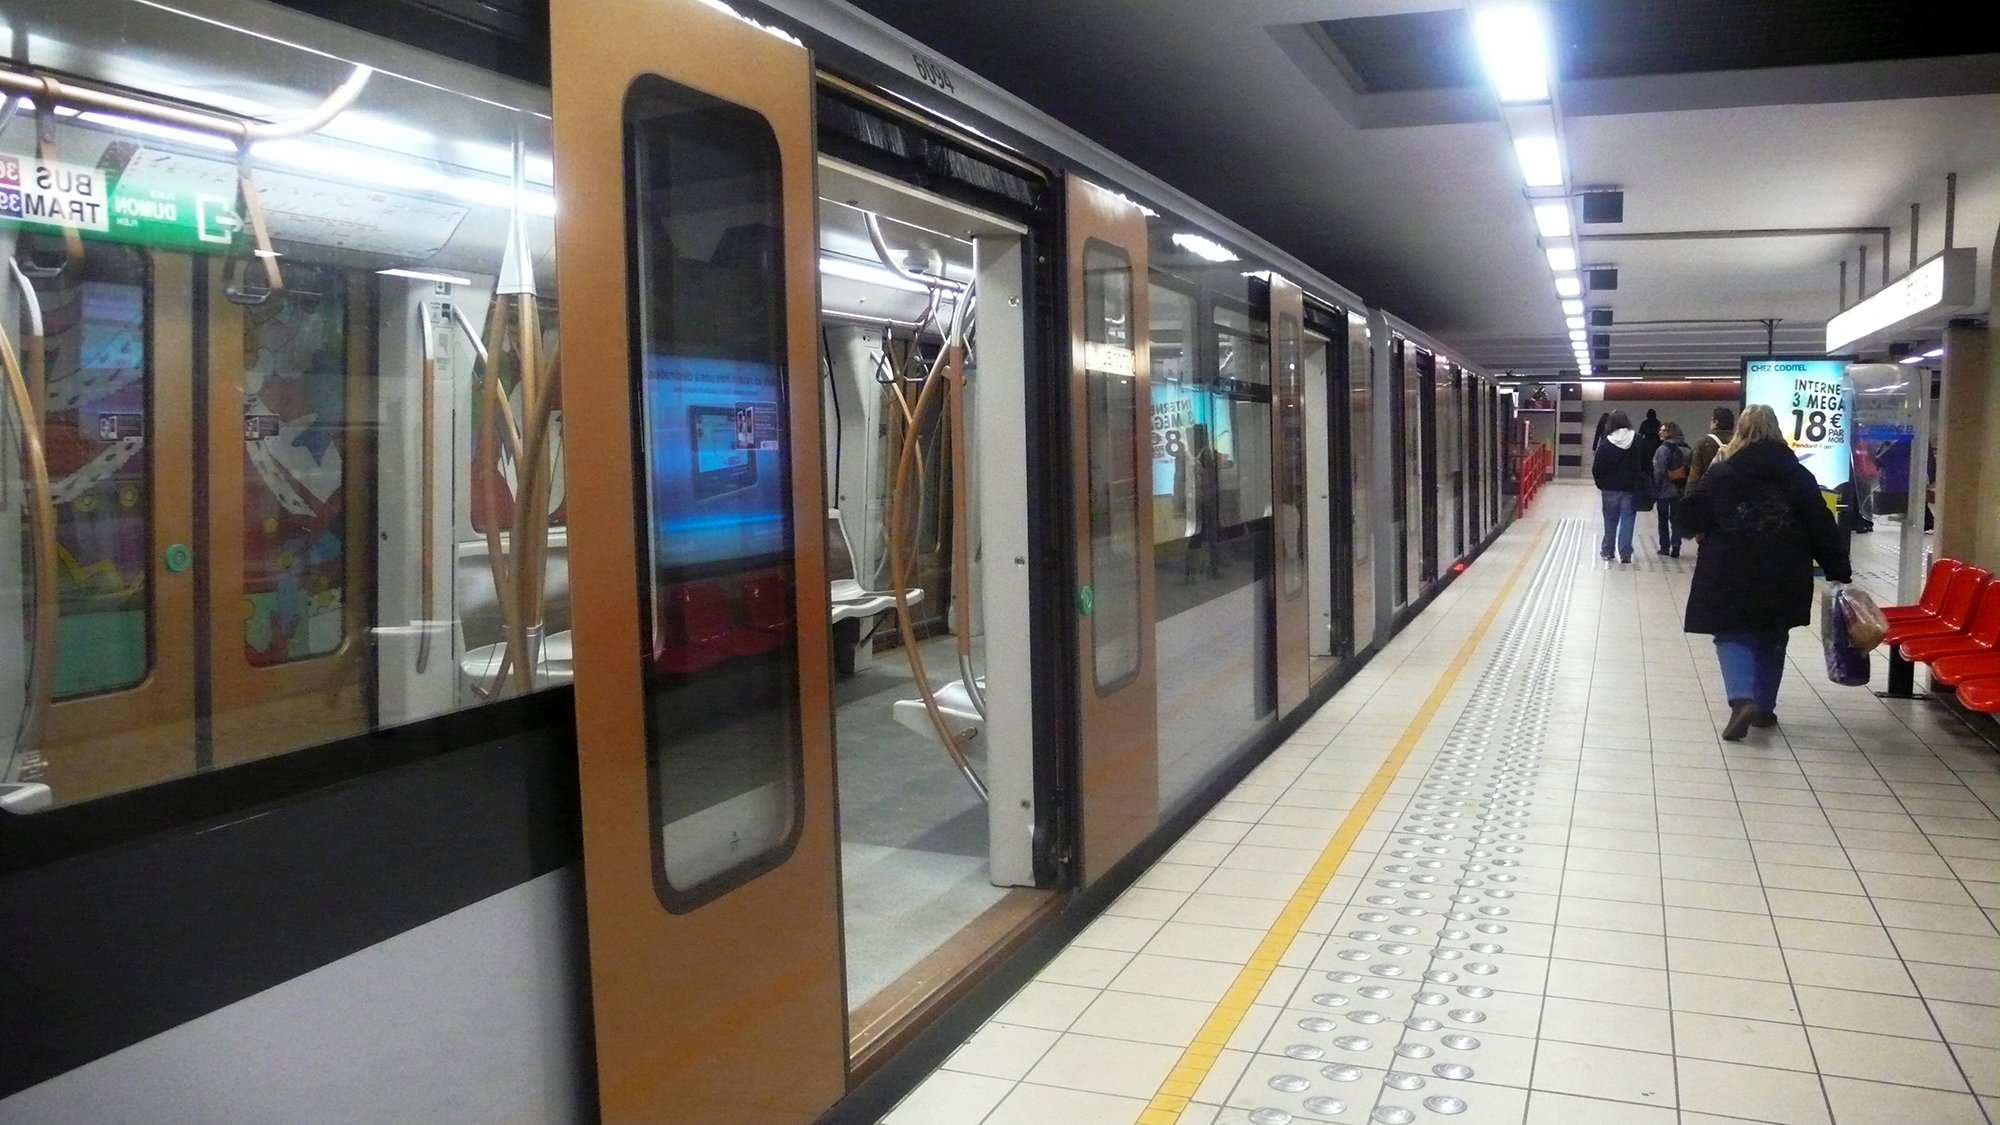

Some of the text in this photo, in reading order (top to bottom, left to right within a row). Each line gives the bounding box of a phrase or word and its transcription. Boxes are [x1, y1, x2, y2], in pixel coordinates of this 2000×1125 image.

[912, 54, 955, 94] 6094
[1751, 364, 1807, 372] CHEZ CODITEL
[1792, 392, 1801, 407] 3
[1828, 429, 1845, 437] PAR
